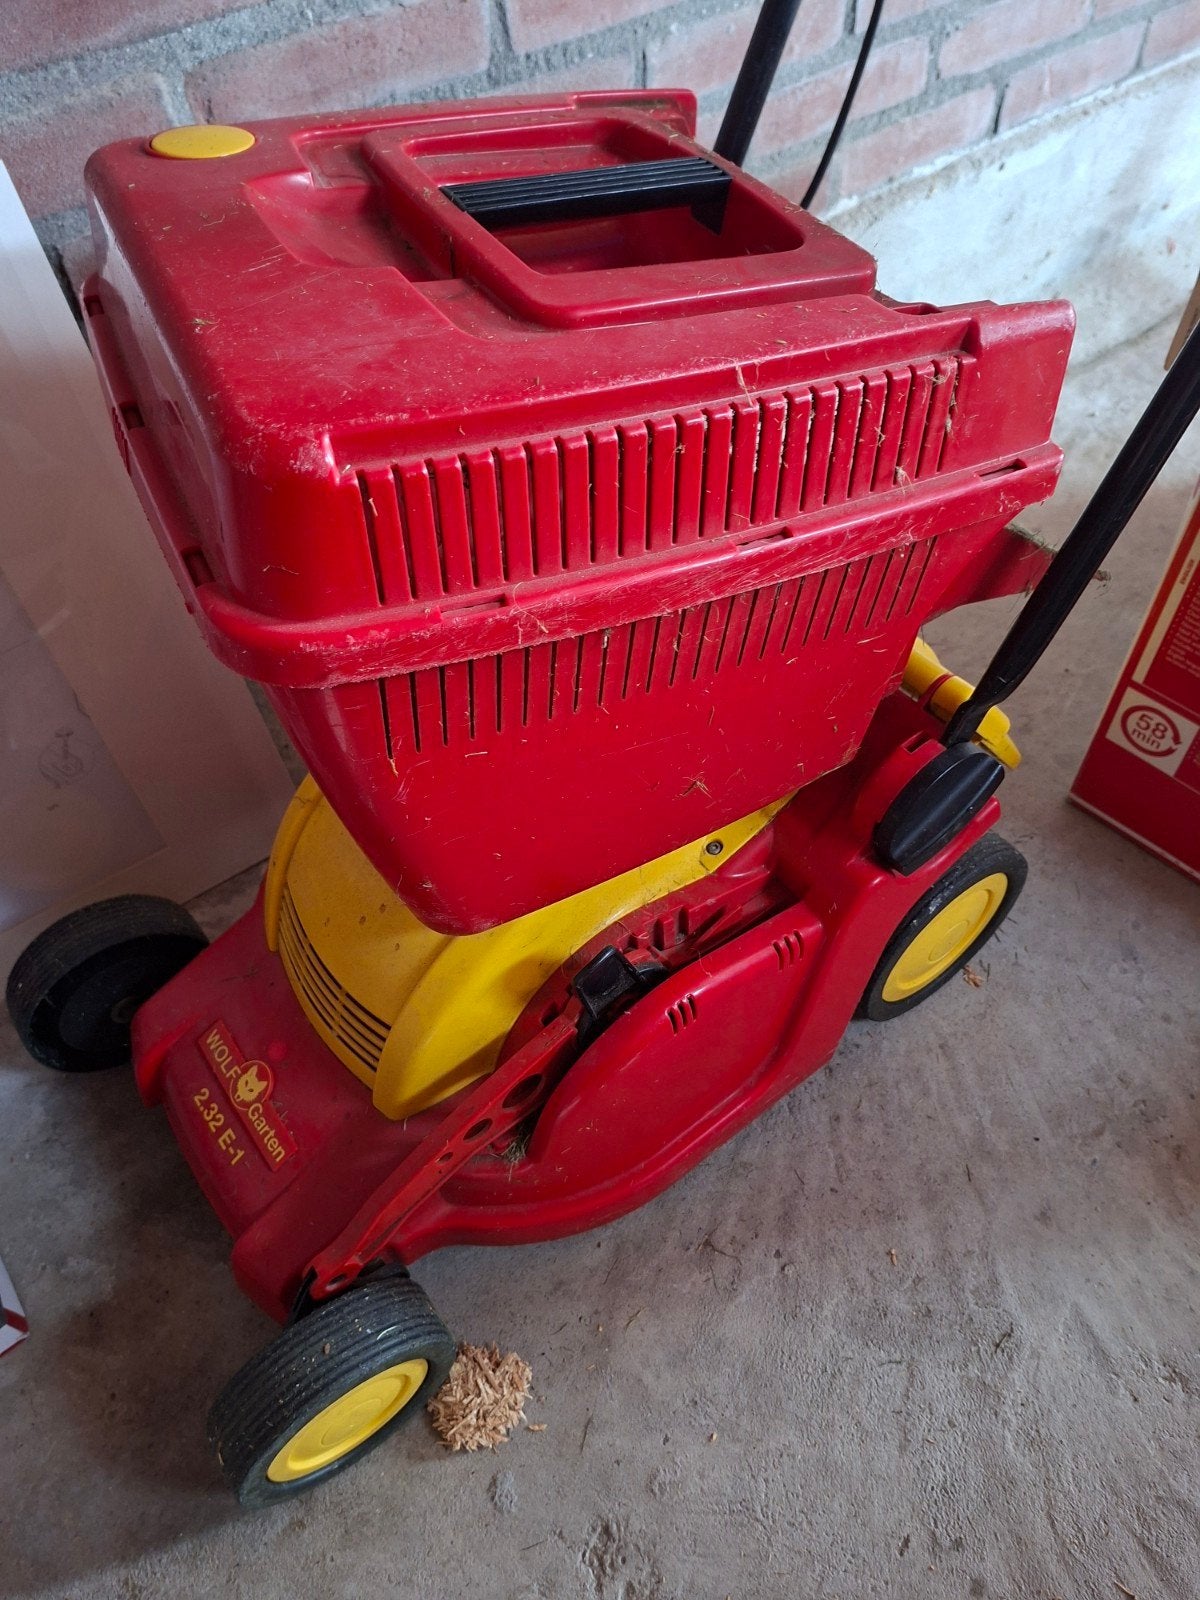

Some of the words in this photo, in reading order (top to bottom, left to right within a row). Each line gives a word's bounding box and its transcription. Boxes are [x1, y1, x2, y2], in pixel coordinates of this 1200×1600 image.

[1131, 728, 1161, 750] min
[1136, 713, 1168, 740] 58
[206, 1028, 242, 1080] WOLF
[248, 1102, 286, 1162] Garten
[193, 1087, 225, 1133] 2.32
[218, 1128, 245, 1166] E-1
